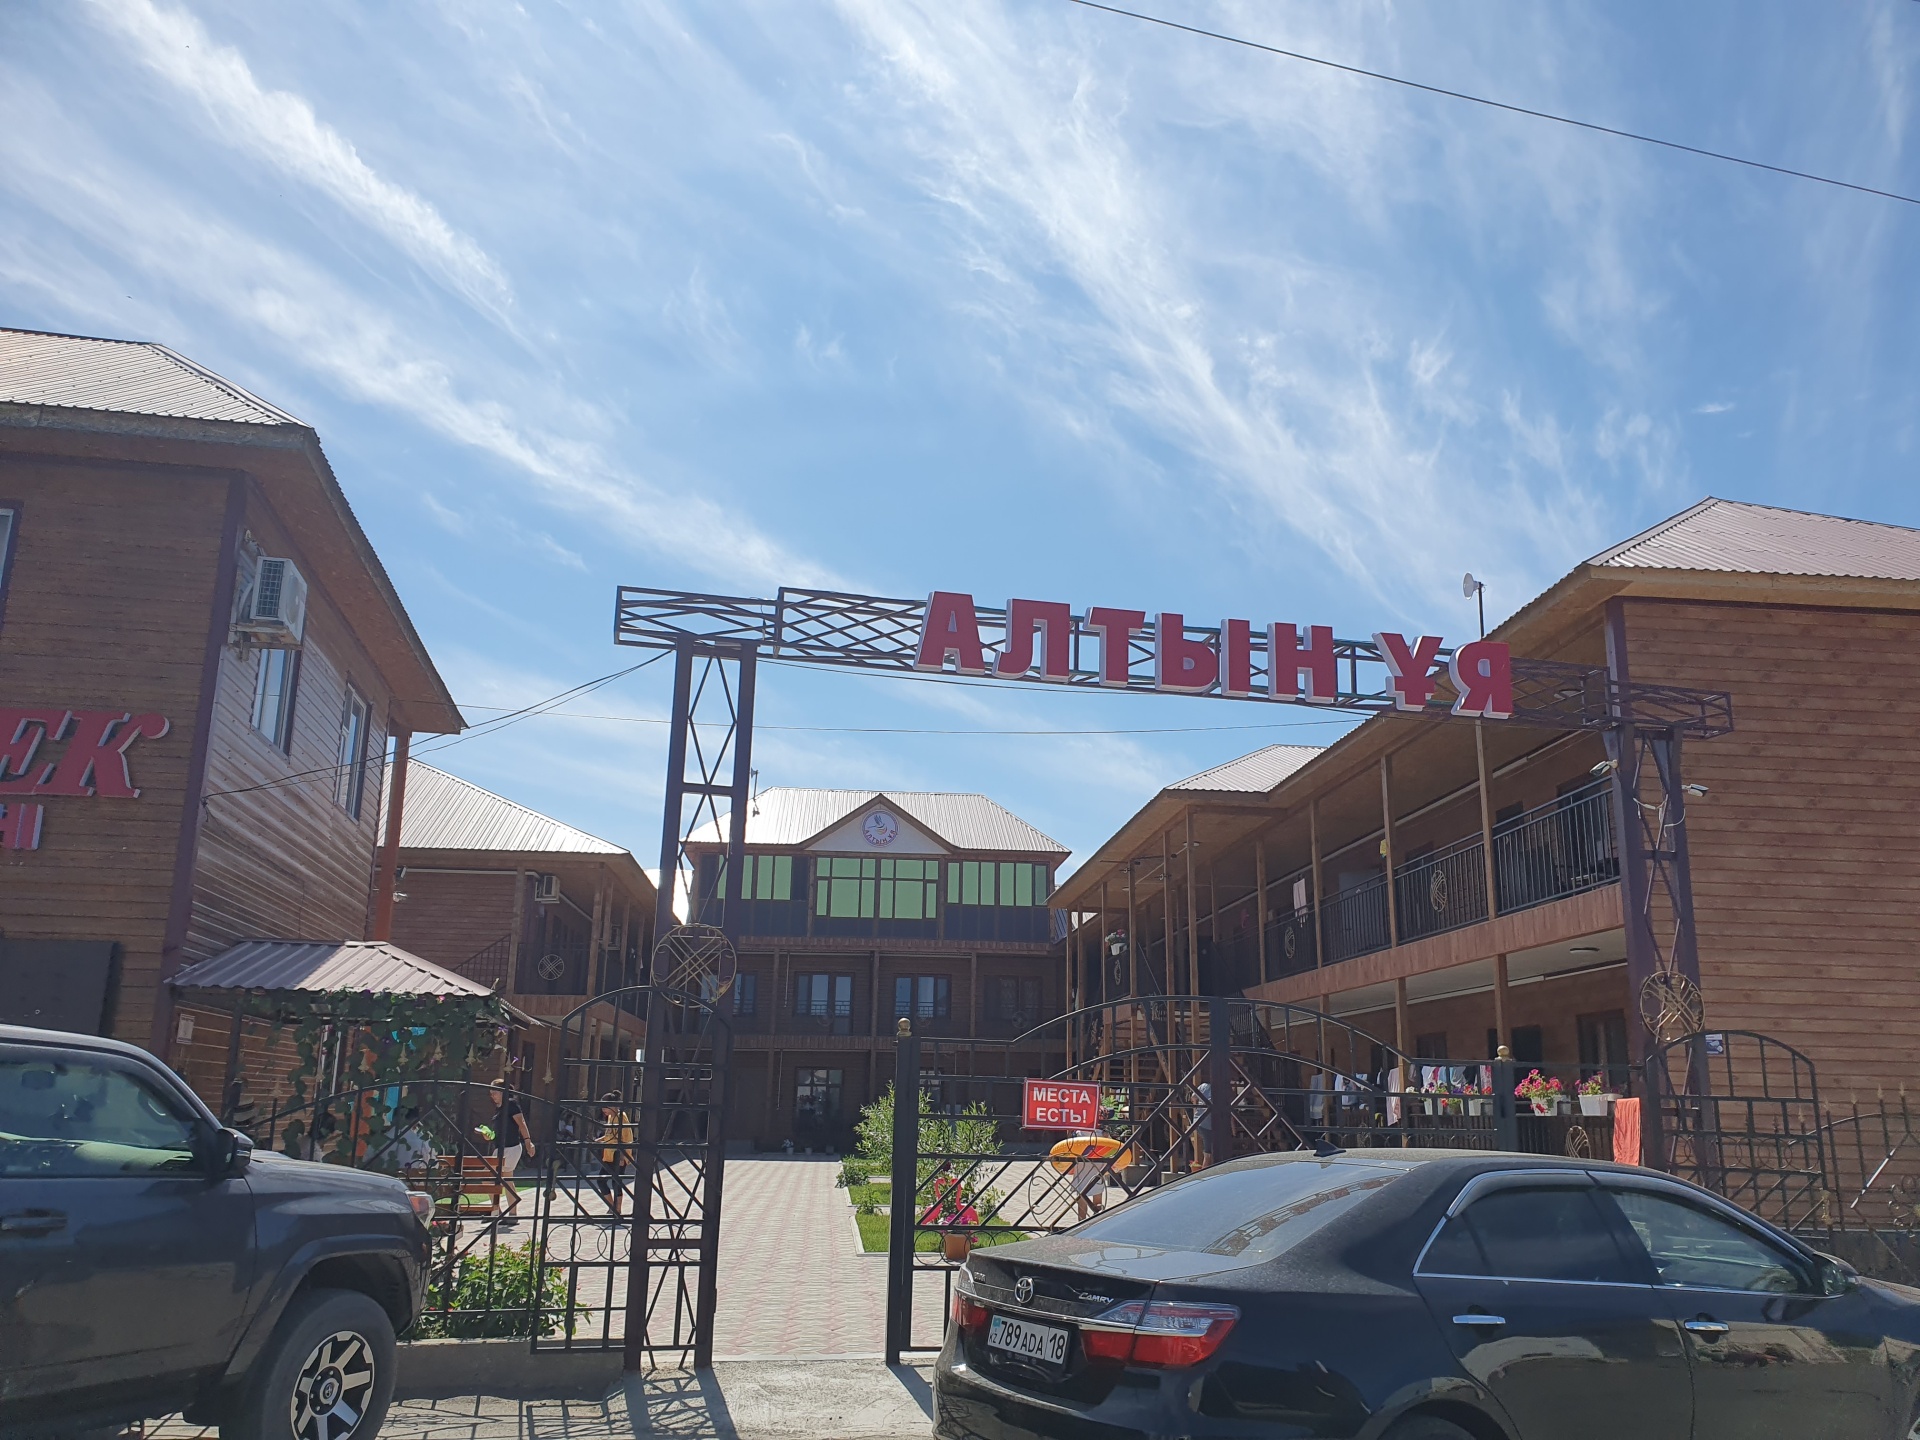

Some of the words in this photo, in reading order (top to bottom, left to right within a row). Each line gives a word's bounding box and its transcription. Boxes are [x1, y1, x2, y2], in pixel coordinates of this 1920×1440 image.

[913, 591, 1336, 703] АЛТЫН
[1372, 632, 1513, 719] ҰЯ
[1033, 1087, 1091, 1104] МЕСТА
[1036, 1107, 1087, 1123] ЕСТЬ!
